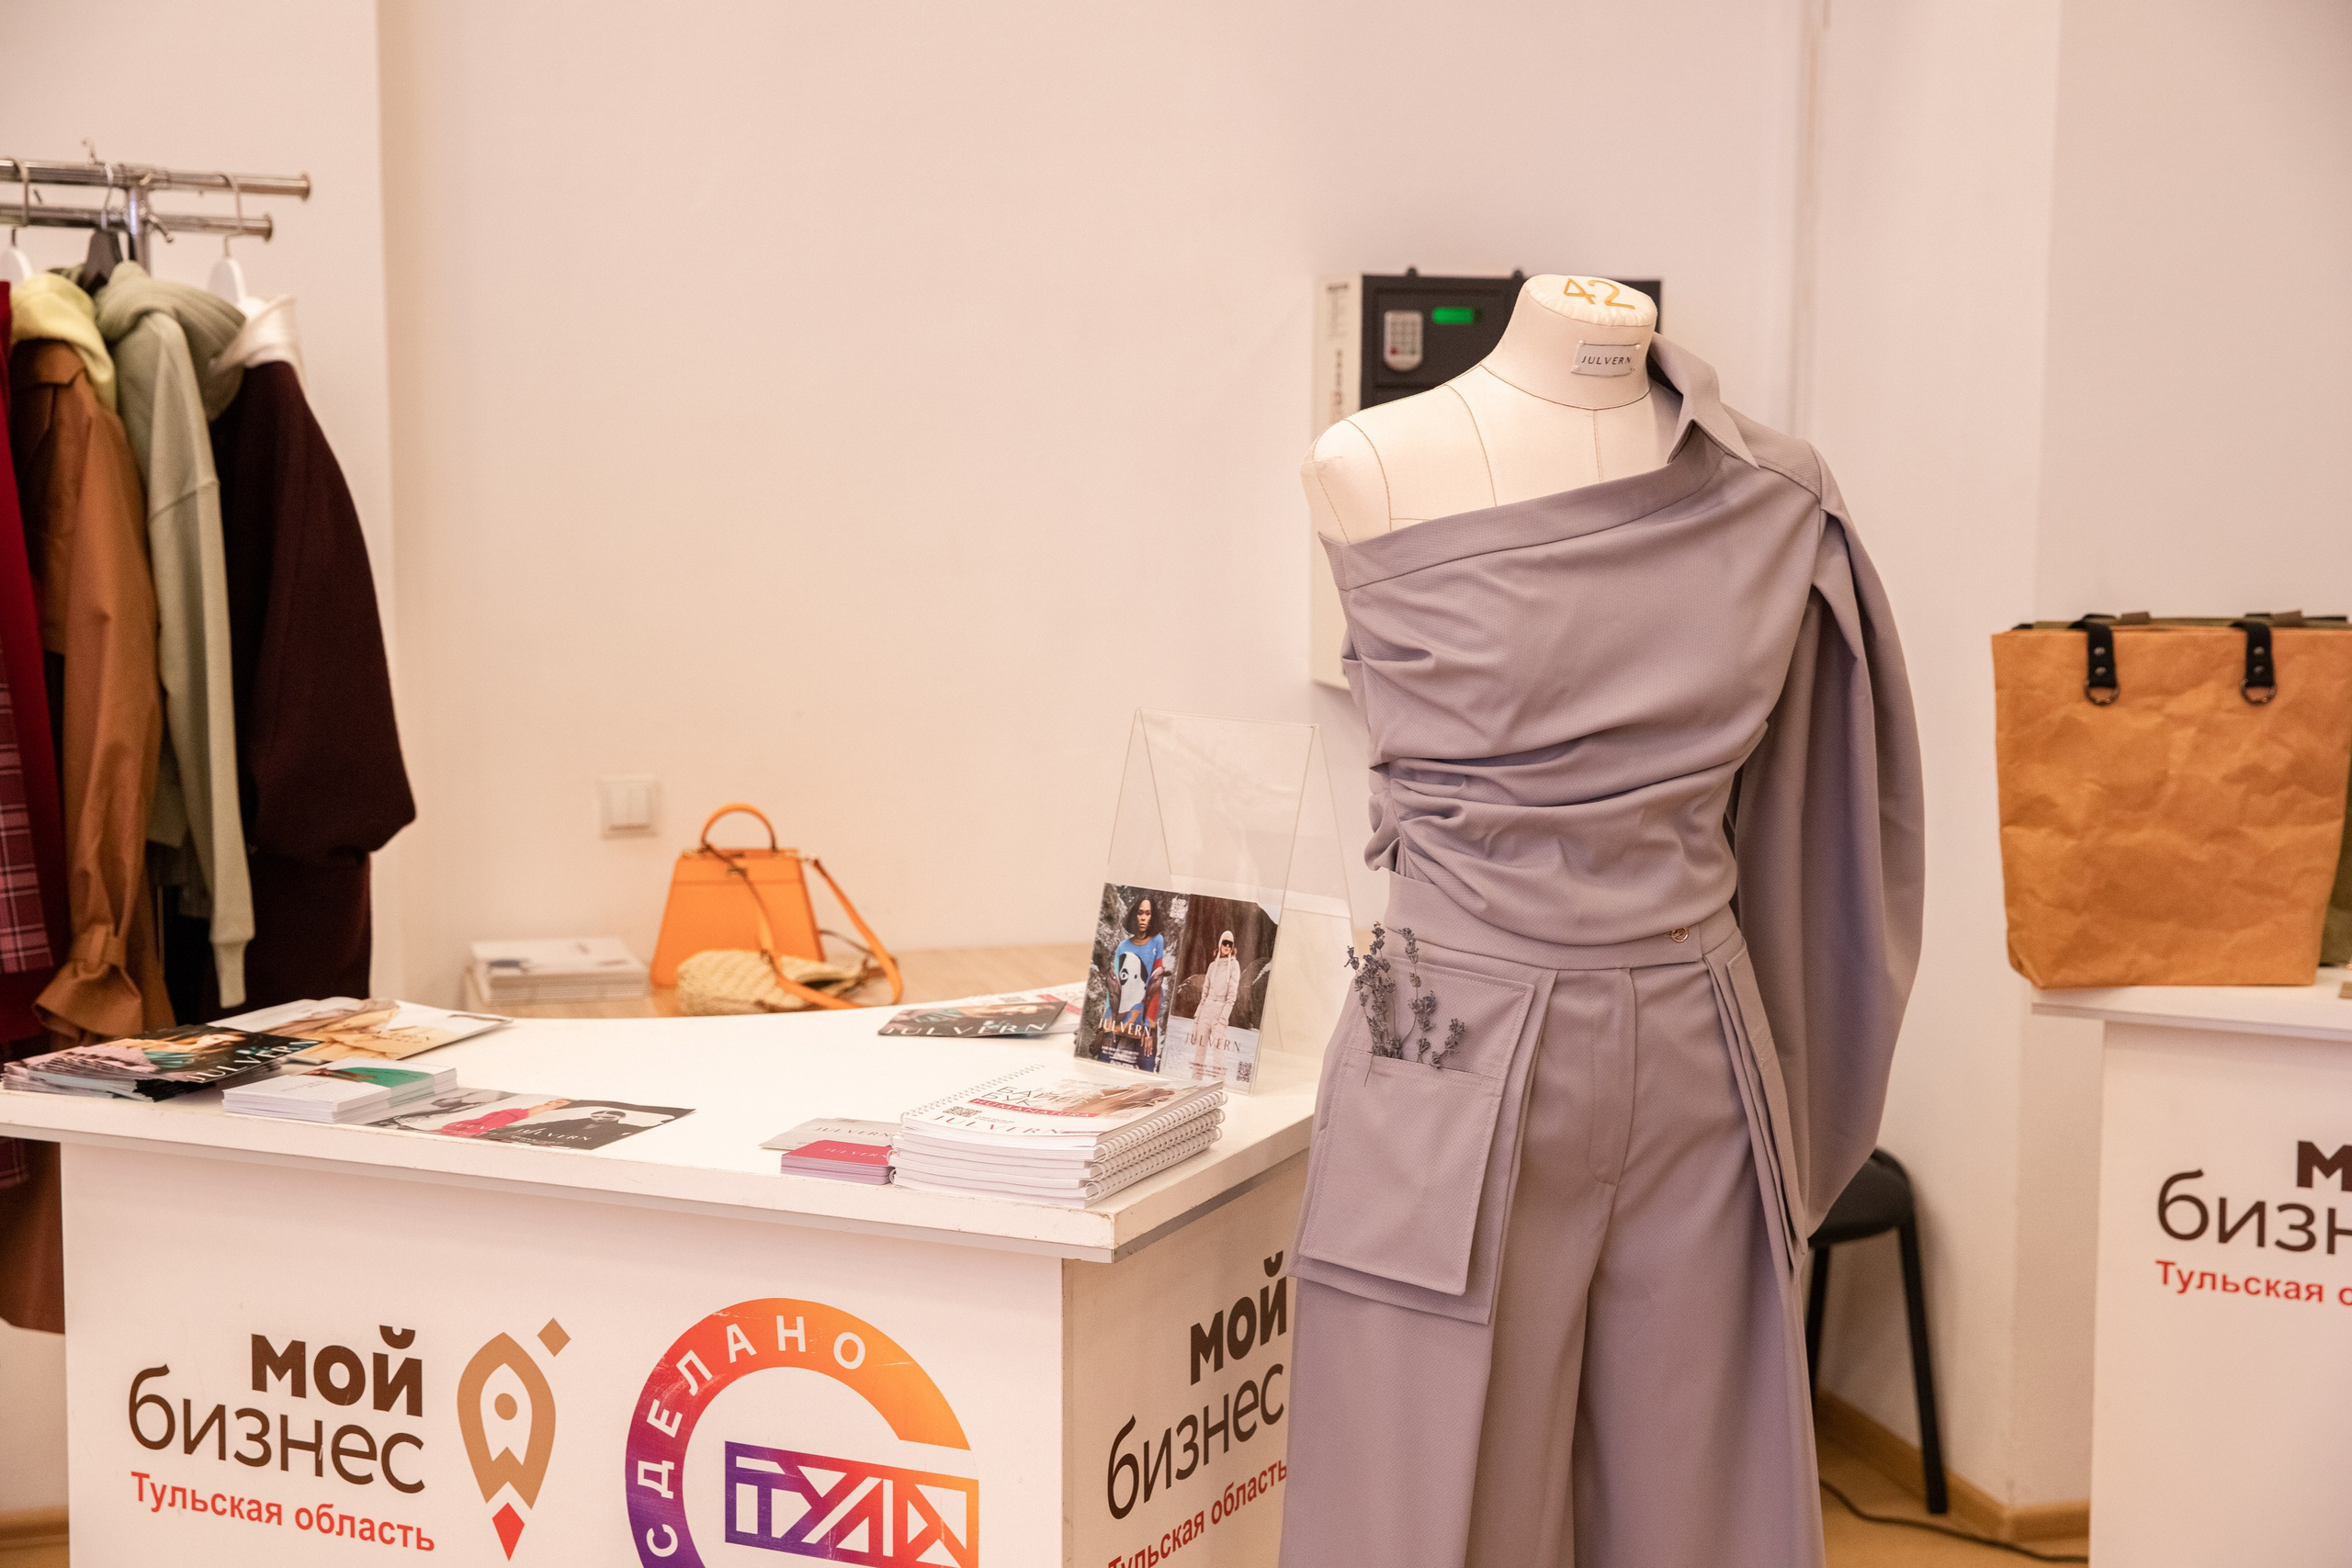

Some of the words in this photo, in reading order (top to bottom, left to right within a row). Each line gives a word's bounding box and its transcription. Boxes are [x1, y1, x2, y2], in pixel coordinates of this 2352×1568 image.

[1563, 278, 1635, 310] 42
[1581, 355, 1632, 365] JULVERN
[885, 1022, 1046, 1035] JULVERN
[1098, 1017, 1151, 1038] JULVERN
[1184, 1032, 1240, 1053] JULVERN
[187, 1038, 320, 1083] JULVERN
[815, 1127, 893, 1137] JULVERN
[931, 1115, 1065, 1134] JULVERN
[2158, 1169, 2352, 1255] бизн
[2155, 1260, 2324, 1303] Тульская
[129, 1364, 425, 1495] бизнес
[638, 1314, 866, 1557] СДЕЛАНО
[1107, 1364, 1284, 1519] бизнес
[130, 1472, 283, 1527] Тульская
[295, 1503, 435, 1552] область
[1211, 1460, 1287, 1525] область
